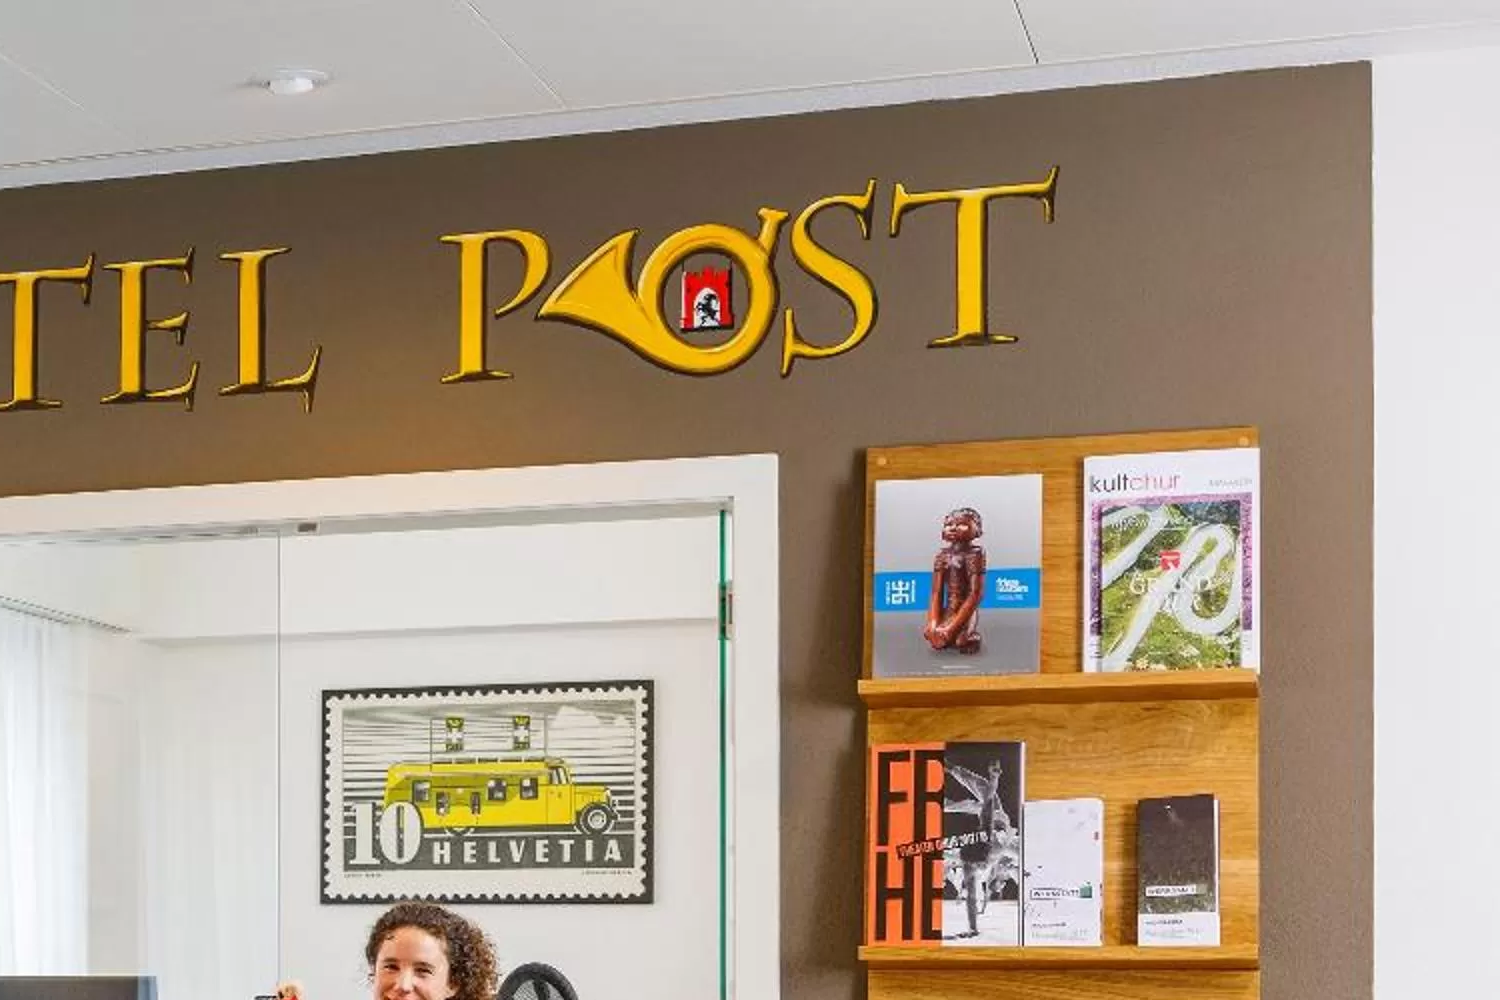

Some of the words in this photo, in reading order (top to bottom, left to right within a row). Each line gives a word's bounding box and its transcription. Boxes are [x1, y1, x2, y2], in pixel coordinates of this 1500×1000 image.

[1090, 473, 1181, 493] kultchur
[350, 800, 422, 865] 10
[432, 838, 623, 865] HELVETIA
